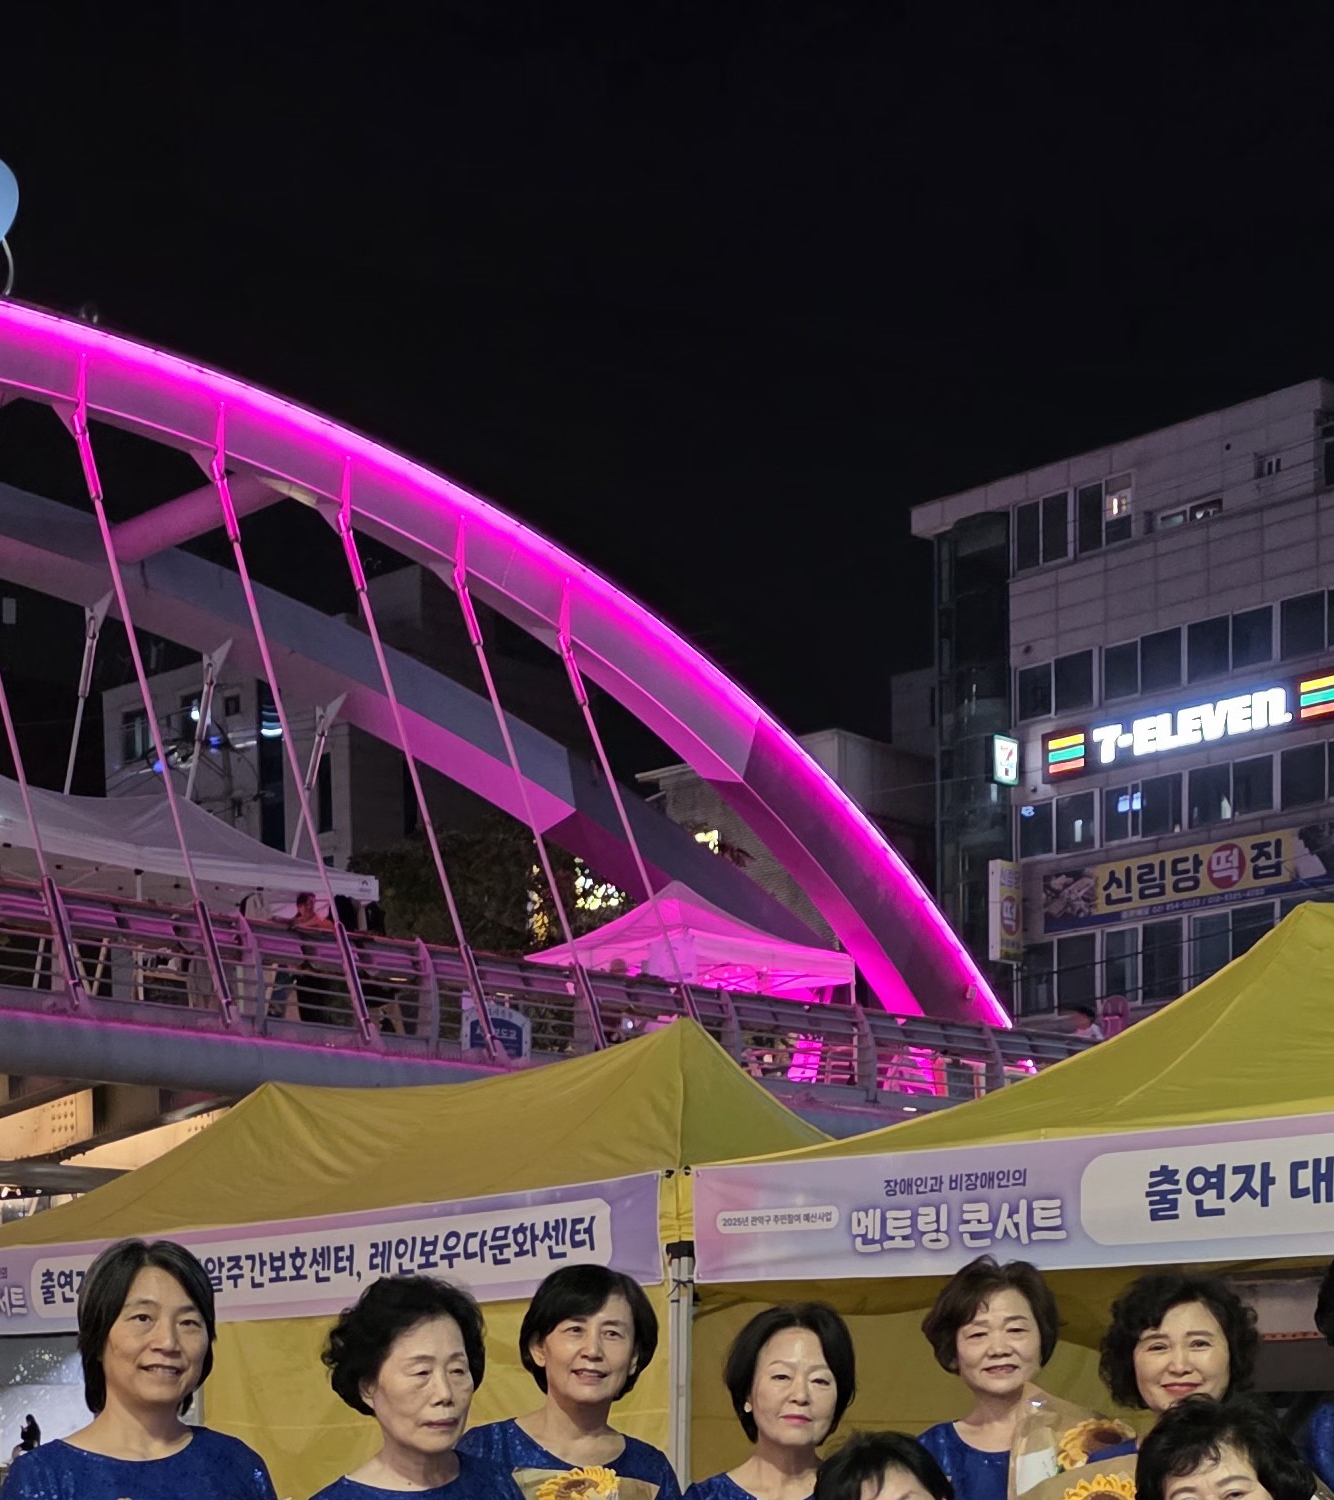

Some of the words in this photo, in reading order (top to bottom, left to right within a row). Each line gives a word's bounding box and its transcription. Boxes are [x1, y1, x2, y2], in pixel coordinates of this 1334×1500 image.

[883, 1174, 943, 1197] 장애인과
[949, 1168, 1028, 1192] 비장애인의
[1145, 1161, 1276, 1221] 출연자
[197, 1243, 362, 1294] 알주간보호센터,
[368, 1215, 598, 1275] 레인보우다문화센터
[851, 1203, 948, 1253] 멘토링
[958, 1199, 1067, 1248] 콘서트
